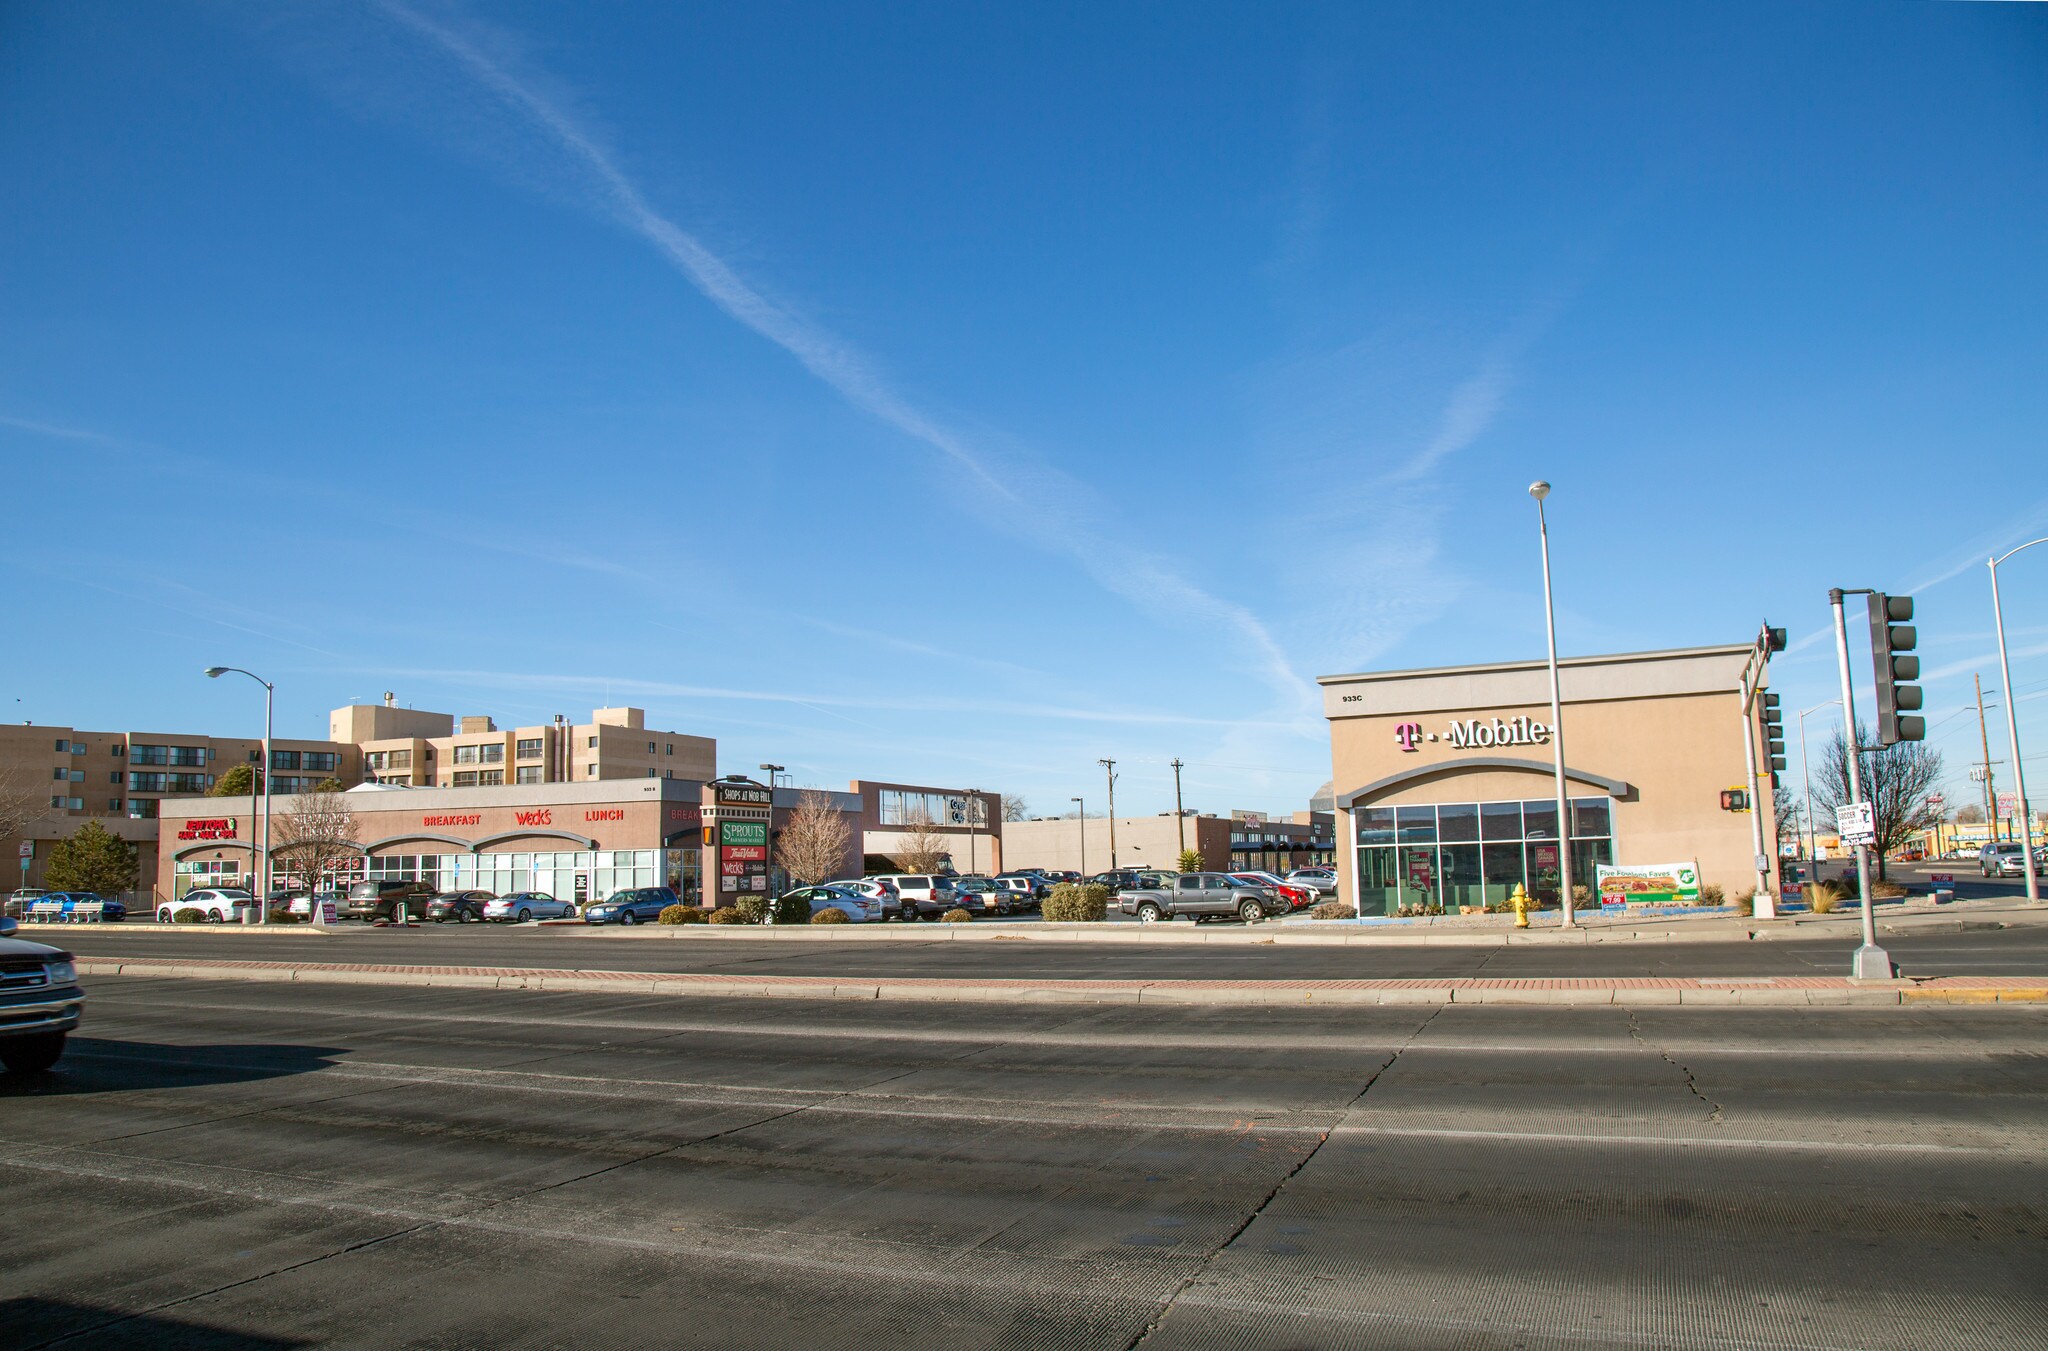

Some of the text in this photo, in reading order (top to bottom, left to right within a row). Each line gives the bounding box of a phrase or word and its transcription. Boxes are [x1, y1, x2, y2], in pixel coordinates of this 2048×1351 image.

[724, 789, 771, 803] SHOPS AT NOB HILL
[423, 814, 481, 827] BREAKFAST
[585, 809, 624, 822] LUNCH
[186, 819, 227, 830] NEW YORK
[178, 831, 196, 840] HAIR
[220, 830, 237, 839] SPA
[723, 823, 765, 840] SPROUTS
[1649, 870, 1671, 878] Faves
